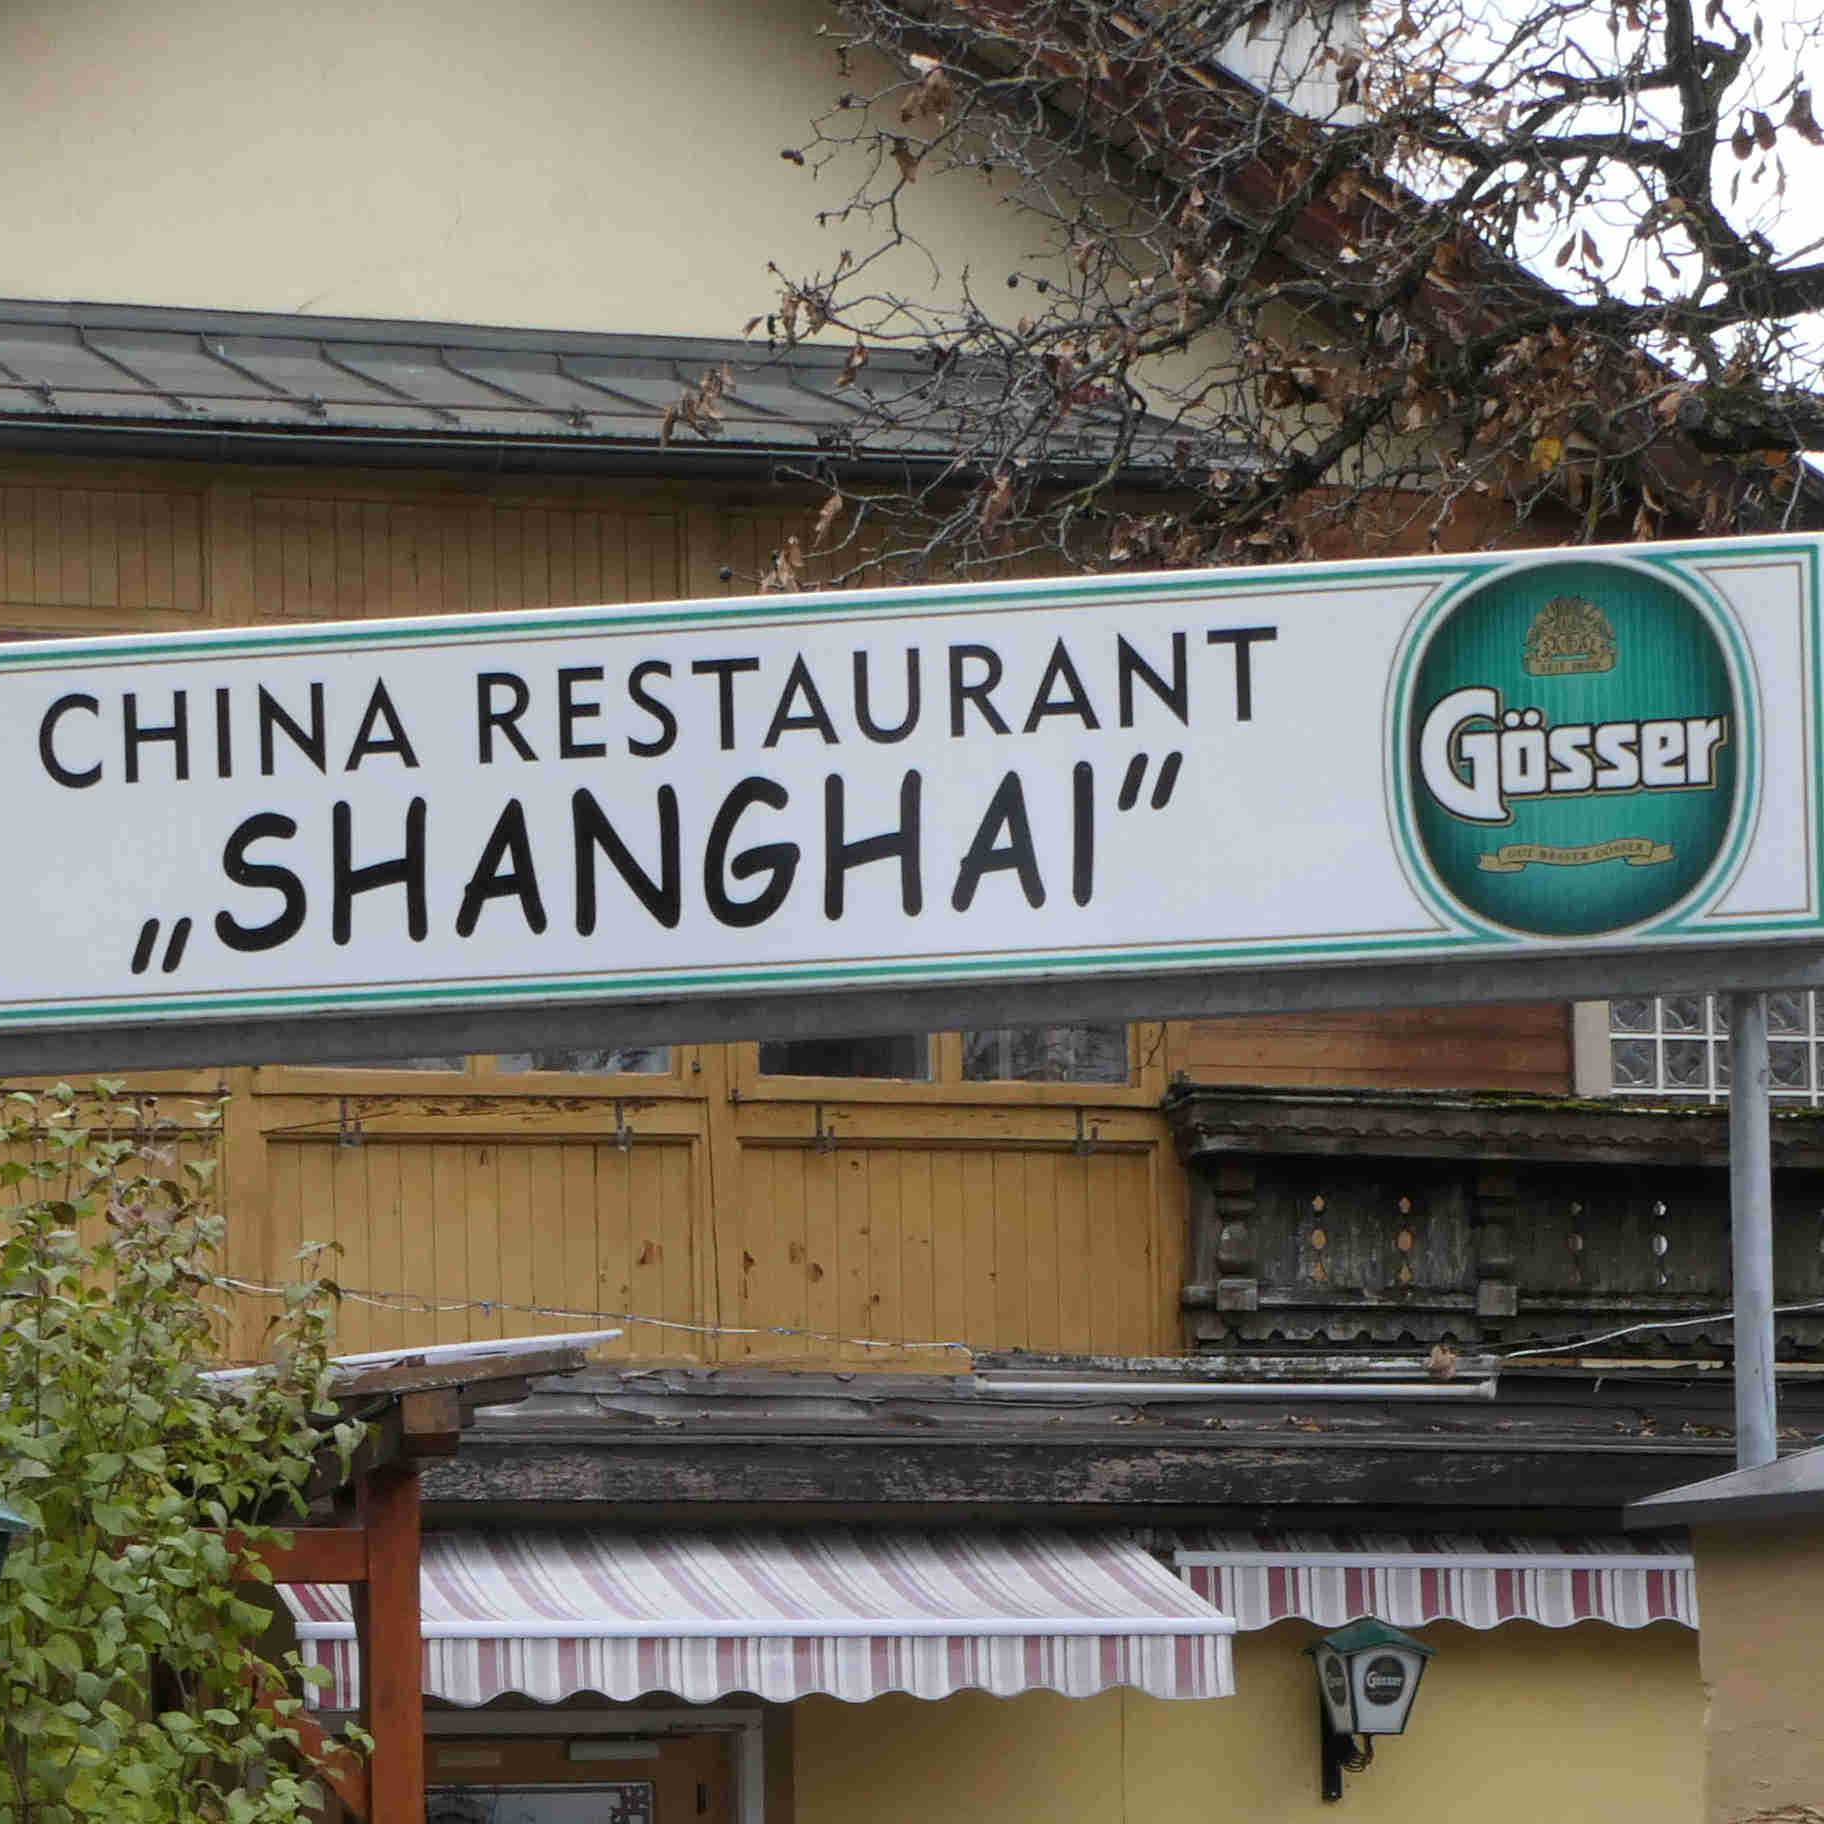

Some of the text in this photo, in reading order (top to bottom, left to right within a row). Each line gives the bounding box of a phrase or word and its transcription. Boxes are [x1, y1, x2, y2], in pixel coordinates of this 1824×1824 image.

[38, 626, 1278, 790] CHINA RESTAURANT
[1420, 685, 1726, 824] Gösser
